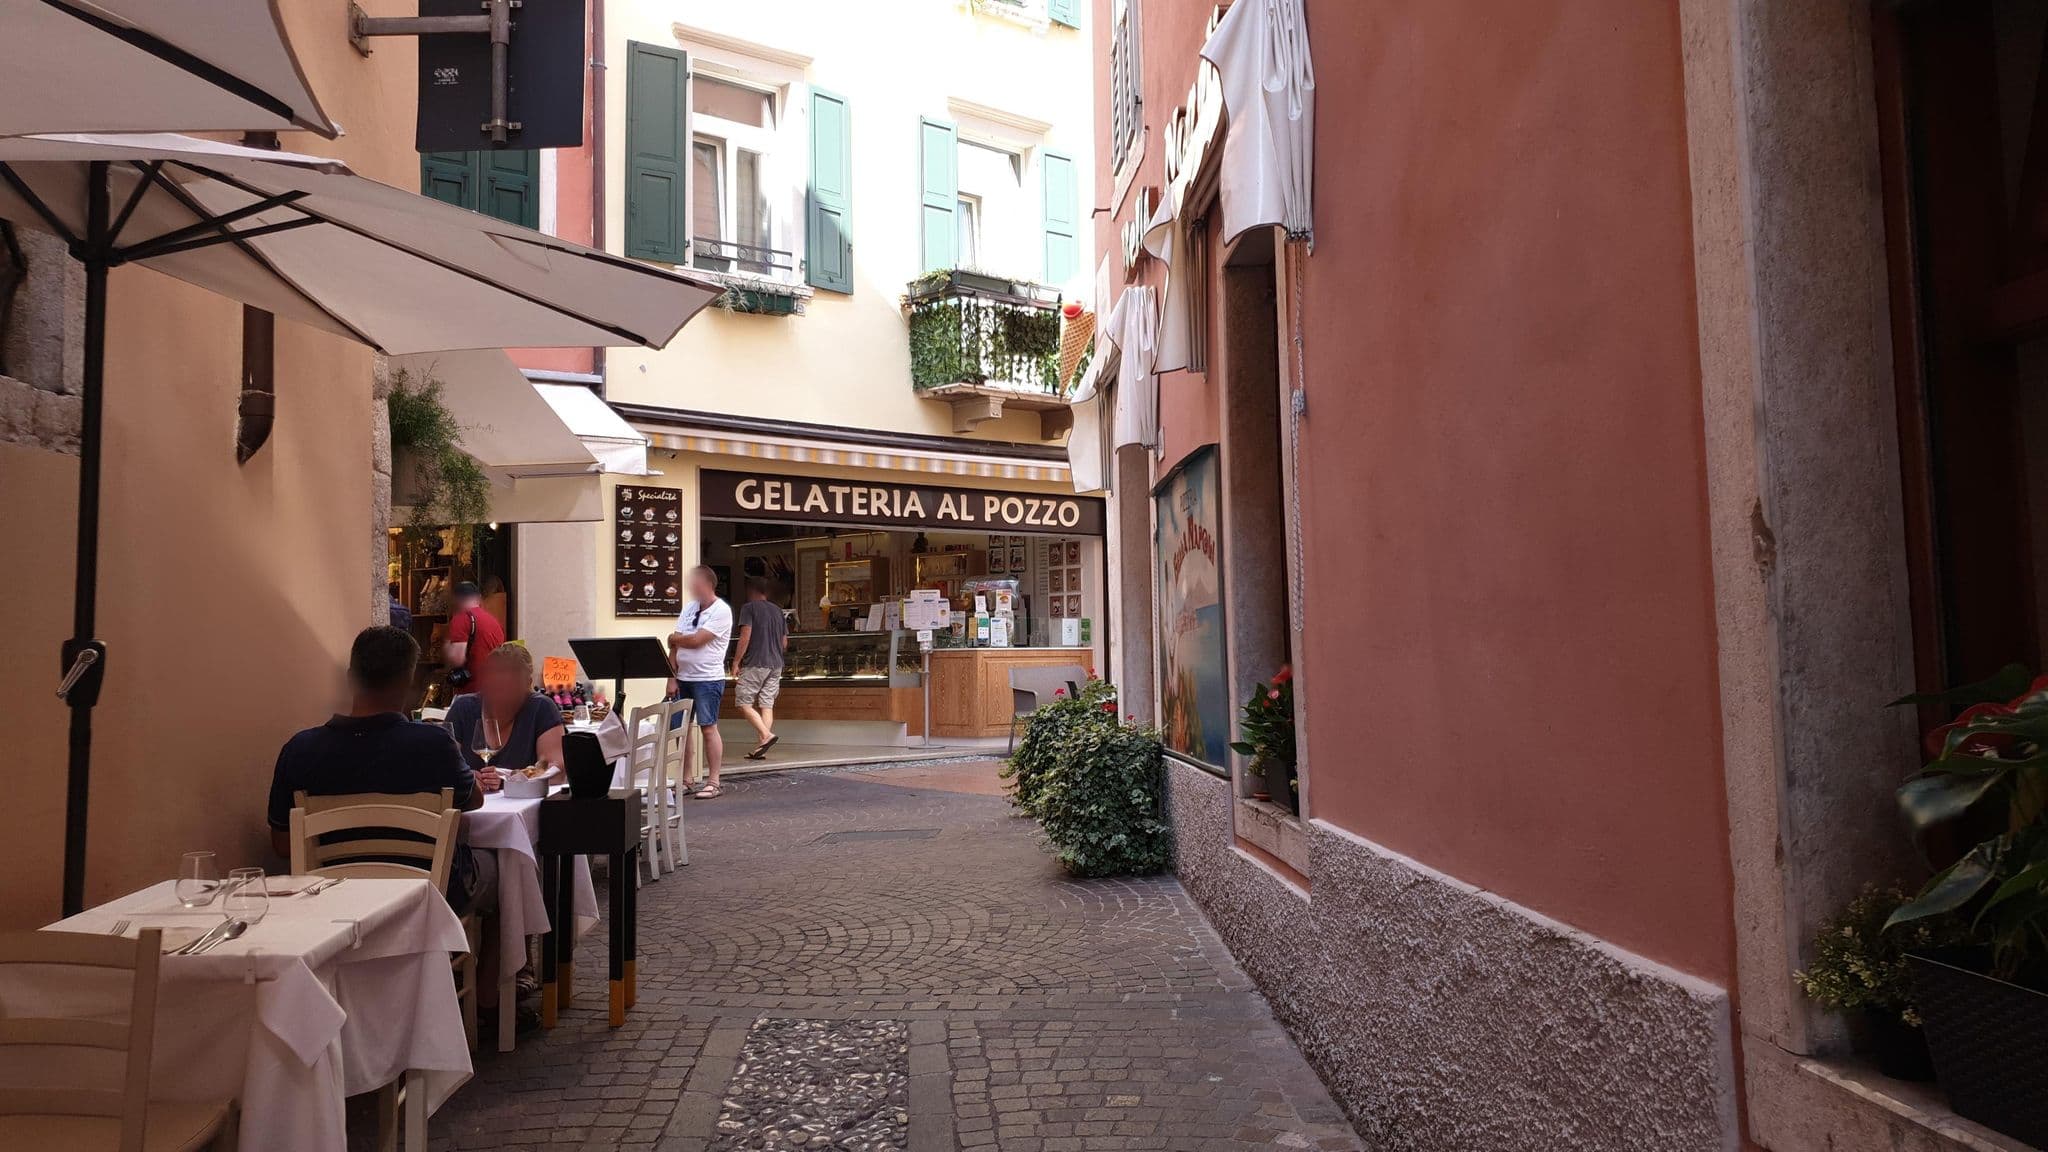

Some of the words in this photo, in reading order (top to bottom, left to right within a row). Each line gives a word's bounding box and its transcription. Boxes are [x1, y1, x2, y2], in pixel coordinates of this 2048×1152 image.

[734, 478, 927, 519] GELATERIA
[936, 493, 975, 522] AL
[983, 495, 1081, 528] POZZO
